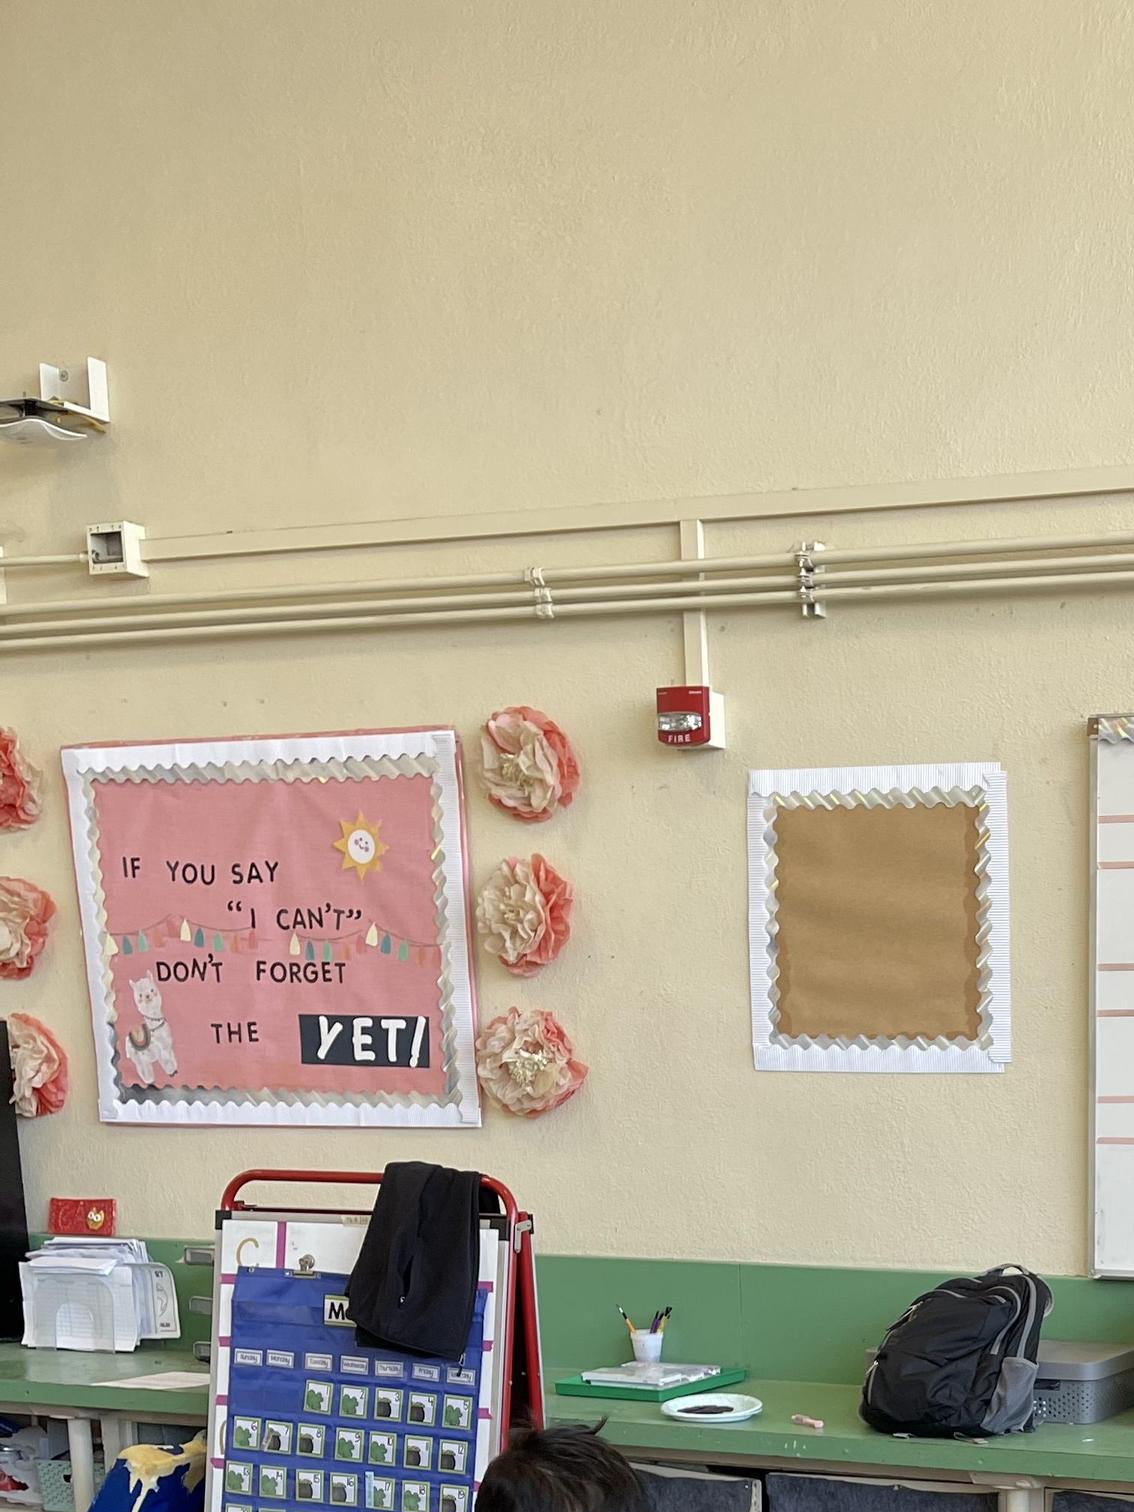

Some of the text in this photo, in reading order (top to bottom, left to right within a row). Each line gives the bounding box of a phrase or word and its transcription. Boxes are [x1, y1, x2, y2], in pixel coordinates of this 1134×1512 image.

[667, 733, 691, 743] FIRE
[122, 856, 279, 886] IF YOU SAY
[155, 952, 347, 985] DON'T FORGET
[210, 1014, 427, 1068] THE YET!
